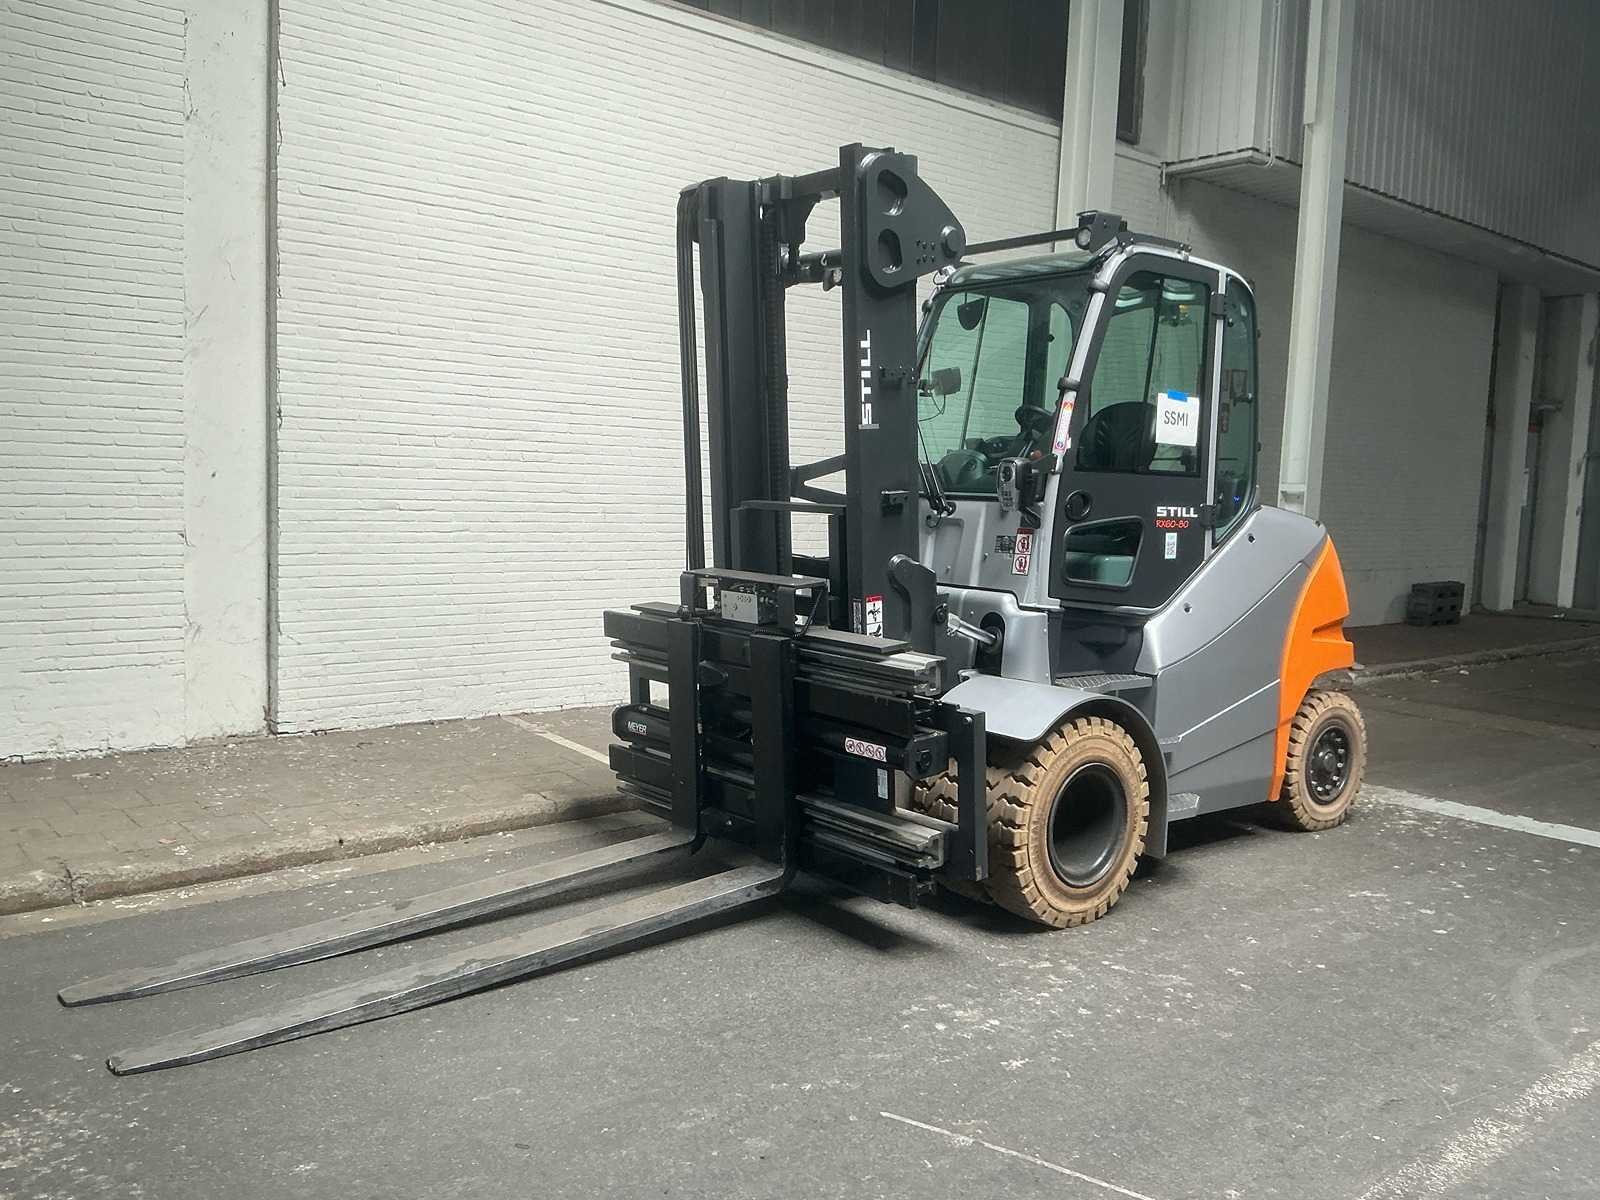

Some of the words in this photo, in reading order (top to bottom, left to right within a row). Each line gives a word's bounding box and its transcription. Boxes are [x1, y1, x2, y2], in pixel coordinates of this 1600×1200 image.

[860, 329, 872, 425] STILL
[1164, 409, 1189, 427] SSMI
[1156, 505, 1199, 518] STILL
[627, 720, 648, 735] MEYER
